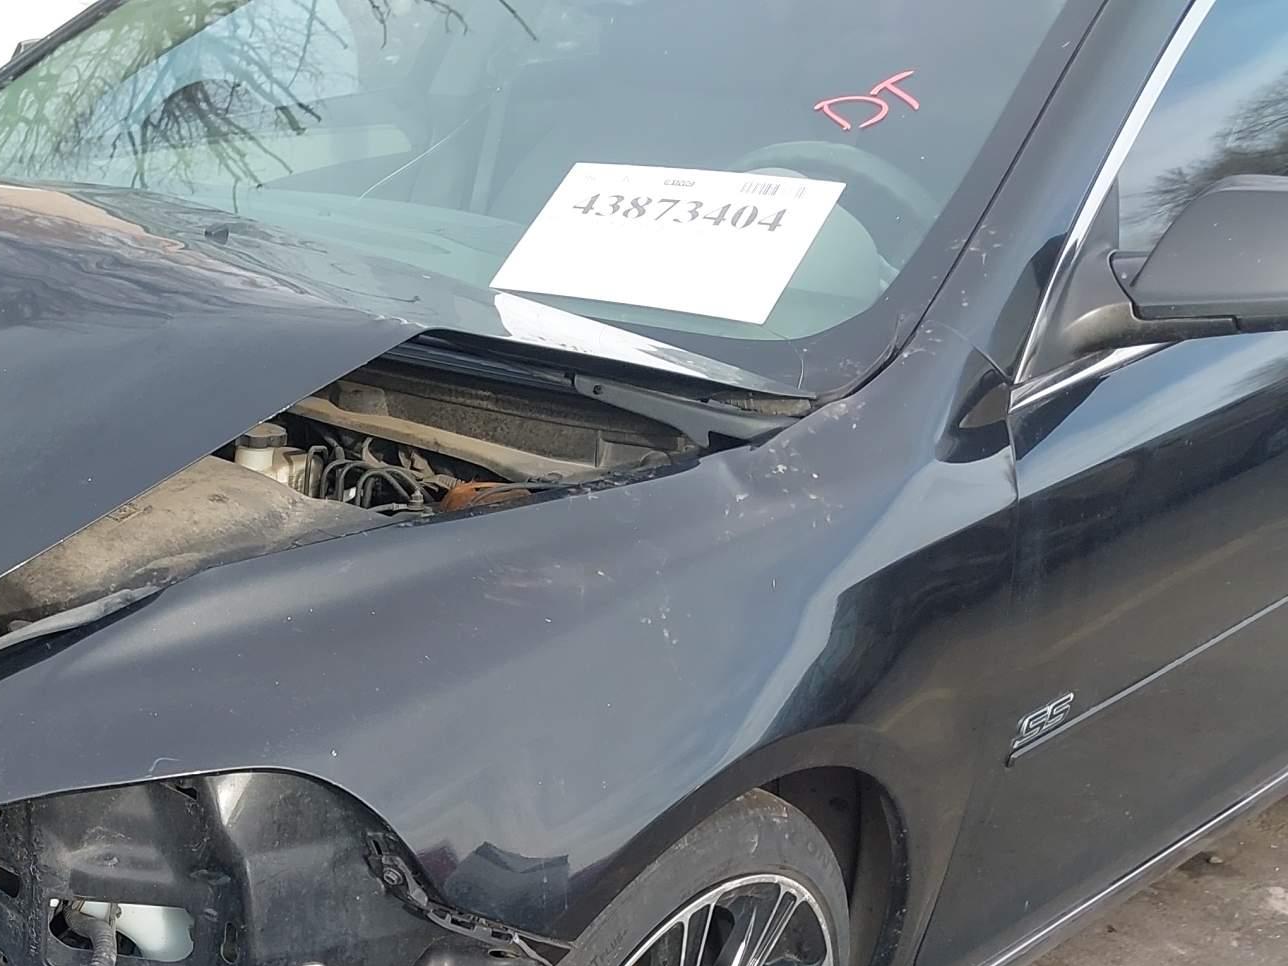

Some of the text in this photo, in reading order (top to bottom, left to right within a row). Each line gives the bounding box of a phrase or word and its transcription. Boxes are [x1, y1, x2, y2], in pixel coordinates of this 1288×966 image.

[813, 70, 921, 131] DT
[572, 192, 789, 232] 43873404
[1012, 691, 1075, 749] SS
